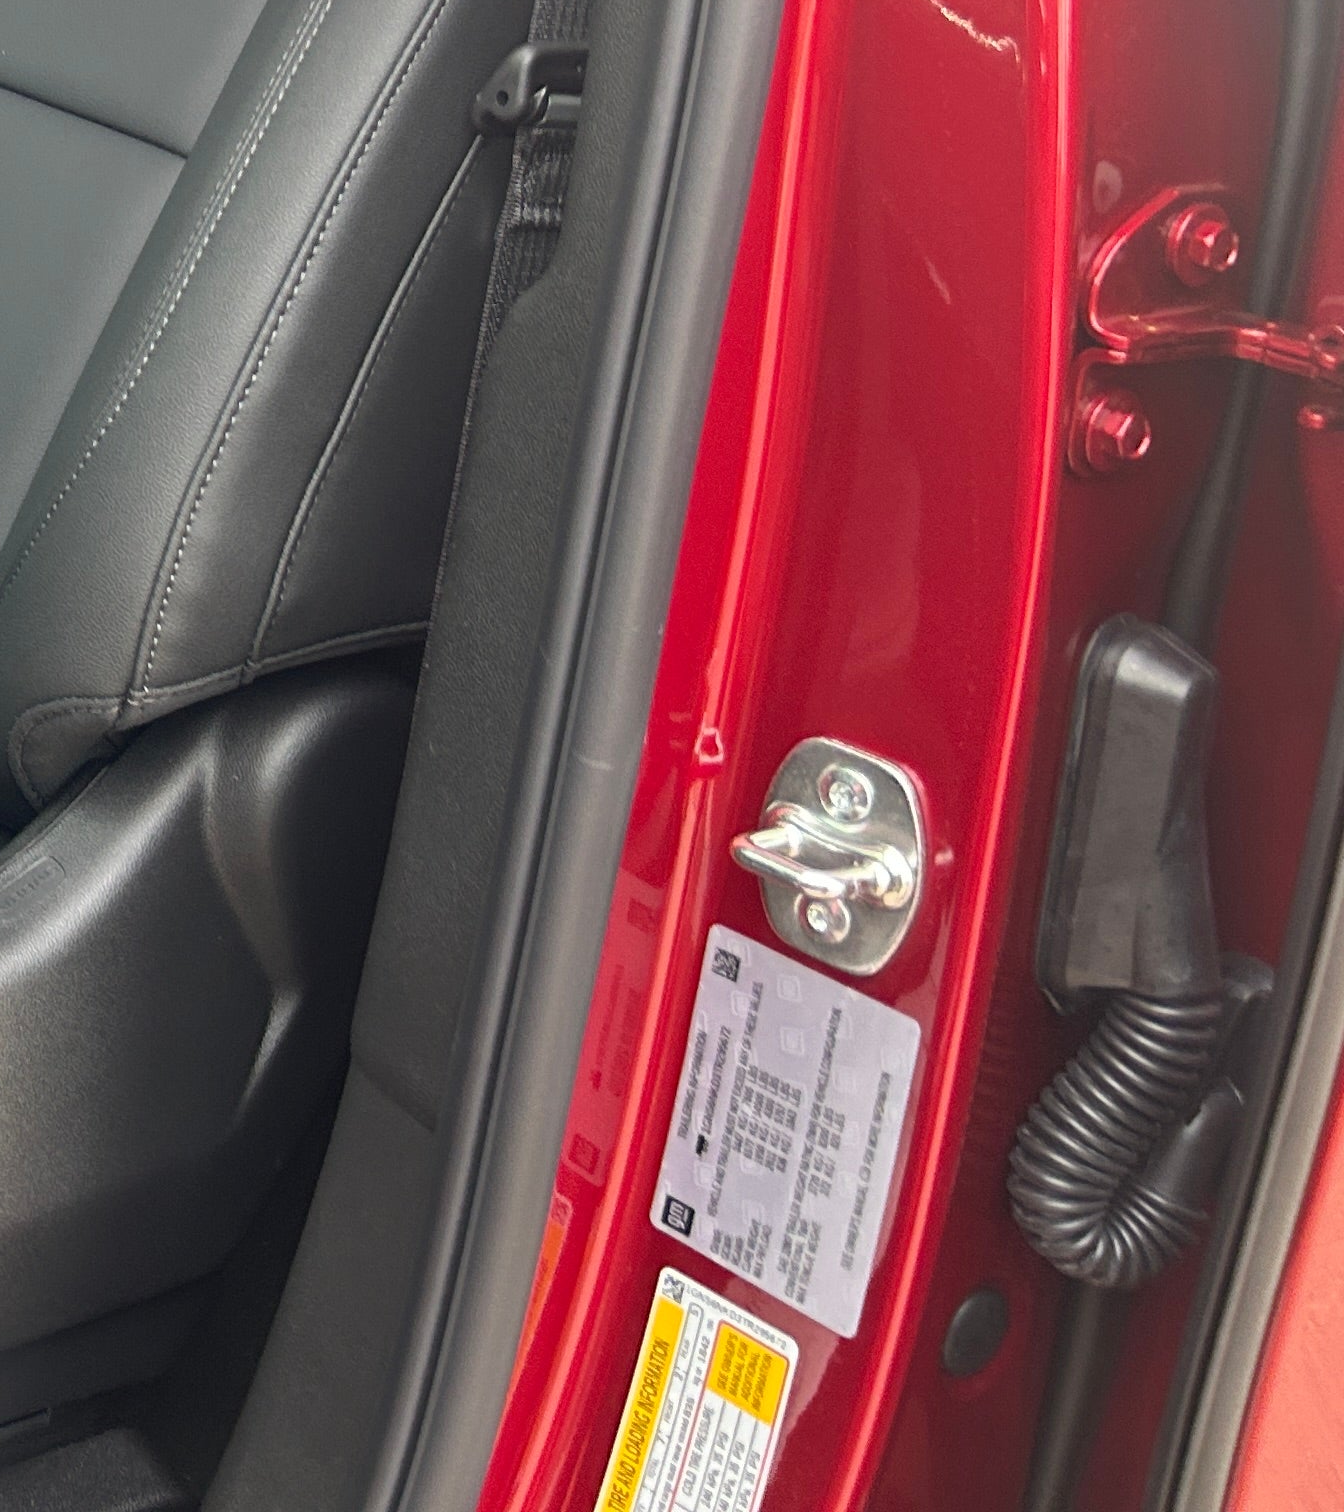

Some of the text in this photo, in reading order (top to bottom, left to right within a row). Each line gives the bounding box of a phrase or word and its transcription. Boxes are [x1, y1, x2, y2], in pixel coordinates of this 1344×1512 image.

[607, 1334, 670, 1512] TIRE AND LOADING INFORMATION
